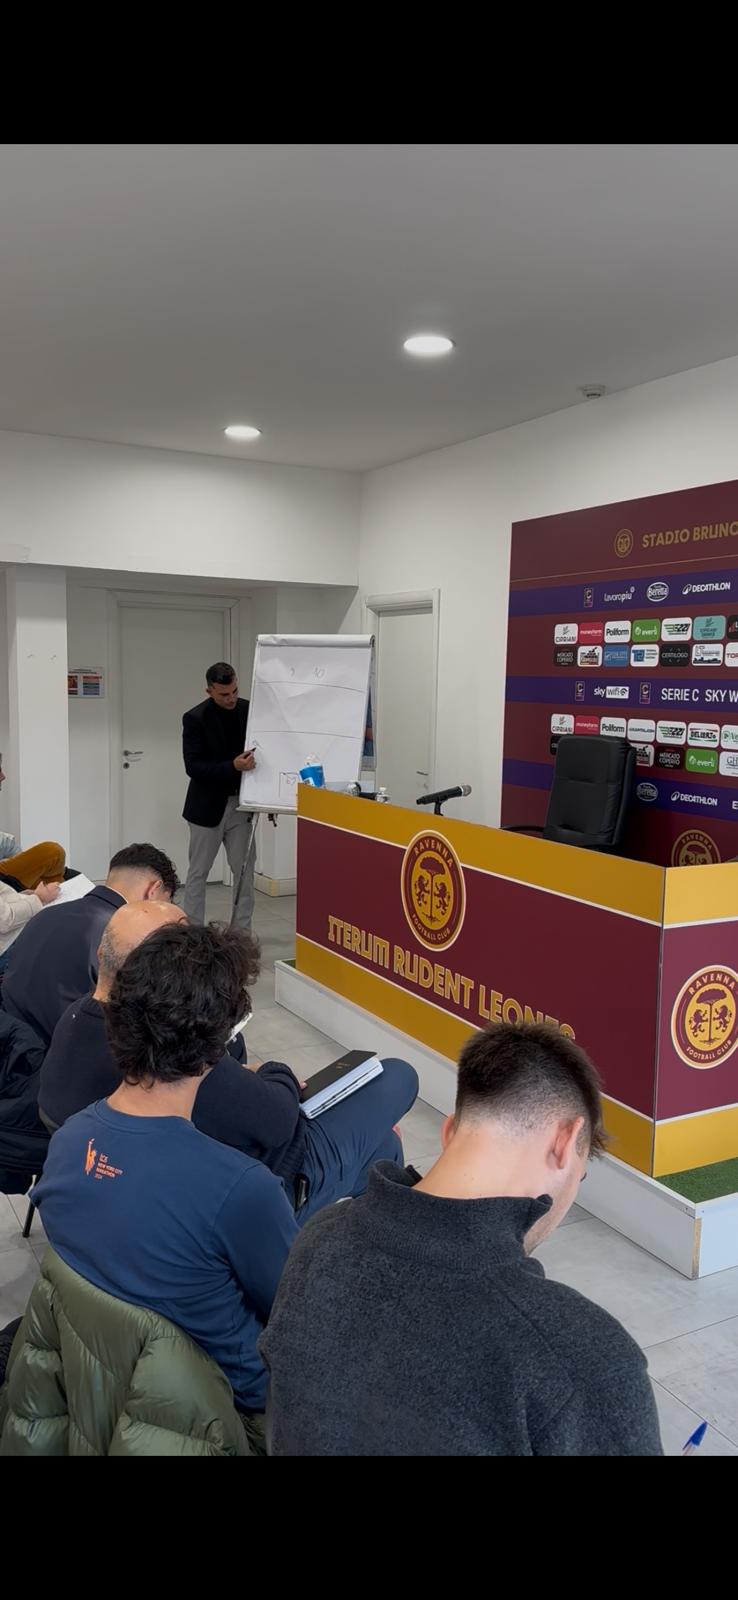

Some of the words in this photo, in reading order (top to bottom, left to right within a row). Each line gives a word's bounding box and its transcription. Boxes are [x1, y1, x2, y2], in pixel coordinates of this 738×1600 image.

[642, 529, 690, 548] STADIO
[693, 521, 738, 541] BRUNO
[692, 582, 731, 593] DECATHLON
[606, 628, 629, 636] Poliform
[594, 686, 606, 697] sky
[661, 687, 691, 701] SERIE
[692, 688, 700, 702] C
[705, 688, 727, 703] SKY
[602, 723, 625, 732] Poliform
[680, 793, 718, 806] DECATHLON
[681, 834, 713, 850] RAVENNA
[413, 838, 454, 868] RAVENNA
[412, 913, 437, 941] FOOTBALL
[437, 927, 452, 941] CLUB
[394, 945, 475, 1009] RUDENT
[688, 974, 736, 995] RAVENNA
[685, 1046, 716, 1061] FOOTBALL
[716, 1040, 733, 1057] CLUB
